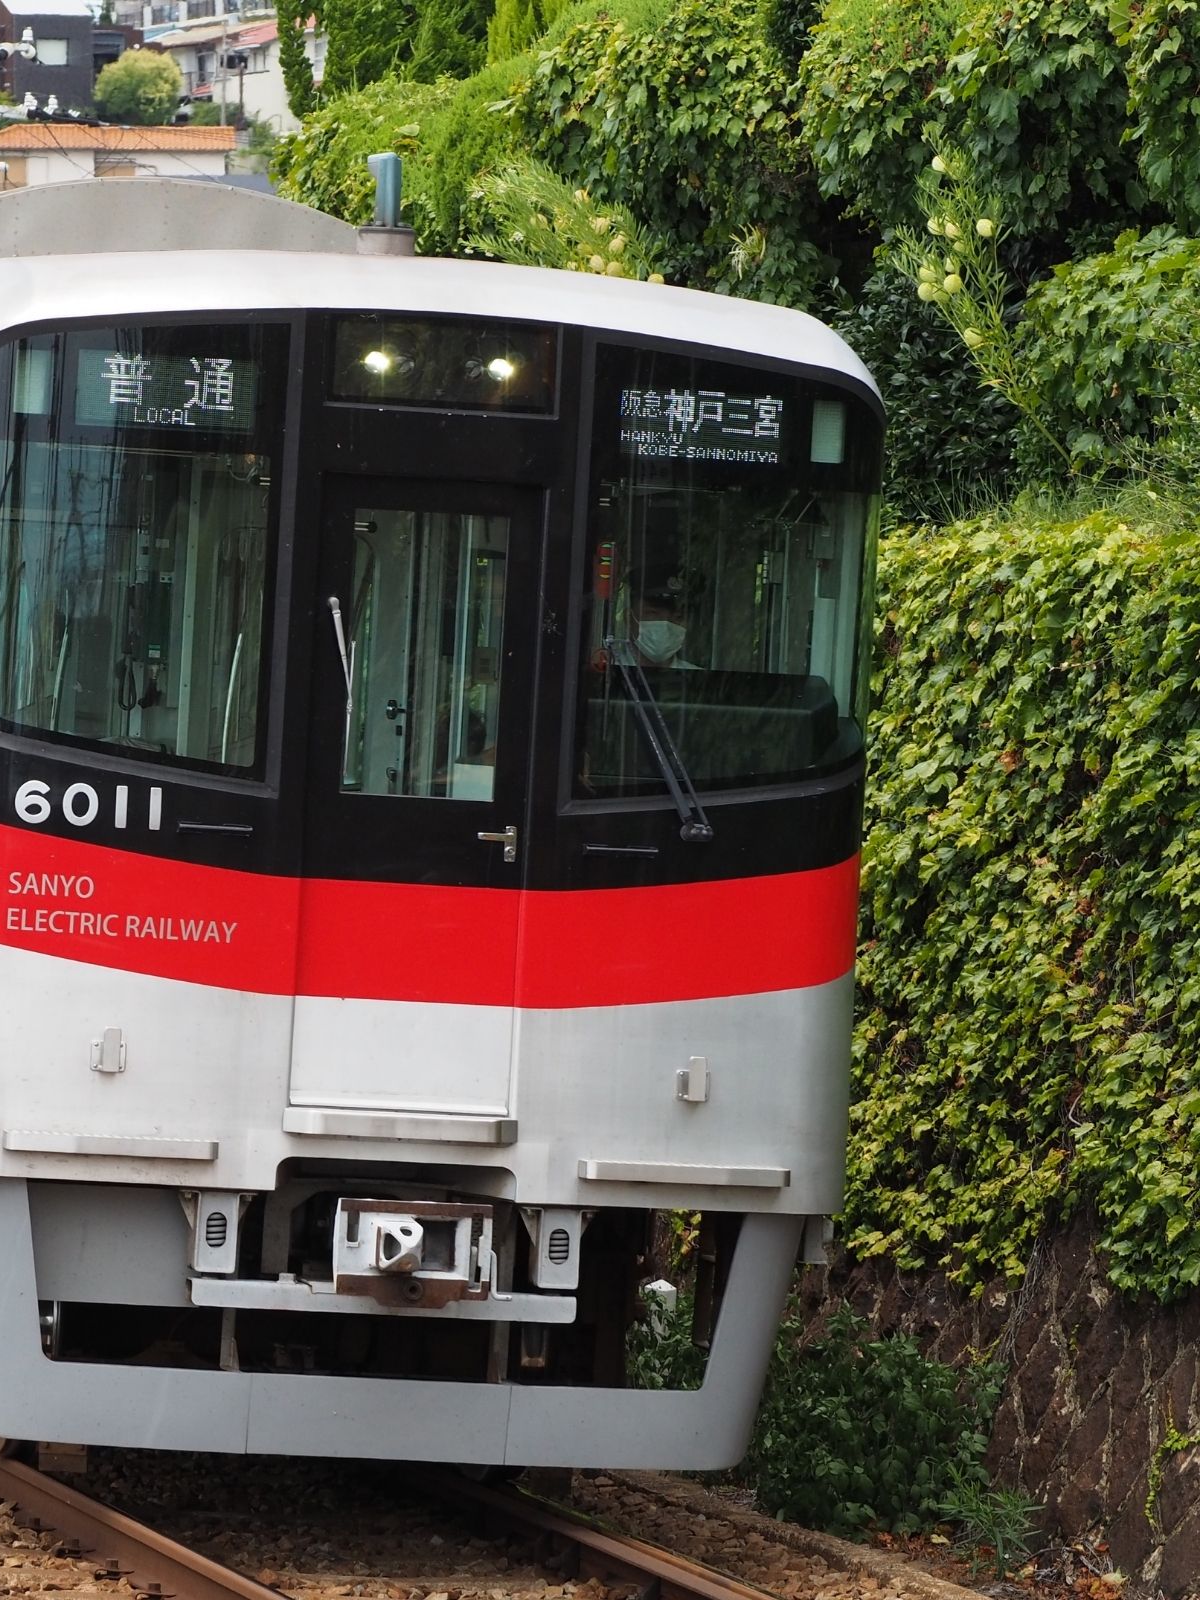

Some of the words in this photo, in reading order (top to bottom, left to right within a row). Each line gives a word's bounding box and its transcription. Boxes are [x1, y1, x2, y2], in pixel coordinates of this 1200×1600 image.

[101, 353, 234, 410] 普通
[133, 407, 196, 425] LOCAL
[620, 429, 683, 444] HANKYU
[637, 443, 779, 464] KOBE-SANNOMIYA
[14, 780, 163, 831] 6011
[8, 872, 95, 899] SANYO
[6, 907, 119, 937] ELECTRIC
[125, 915, 238, 944] RAILWAY
